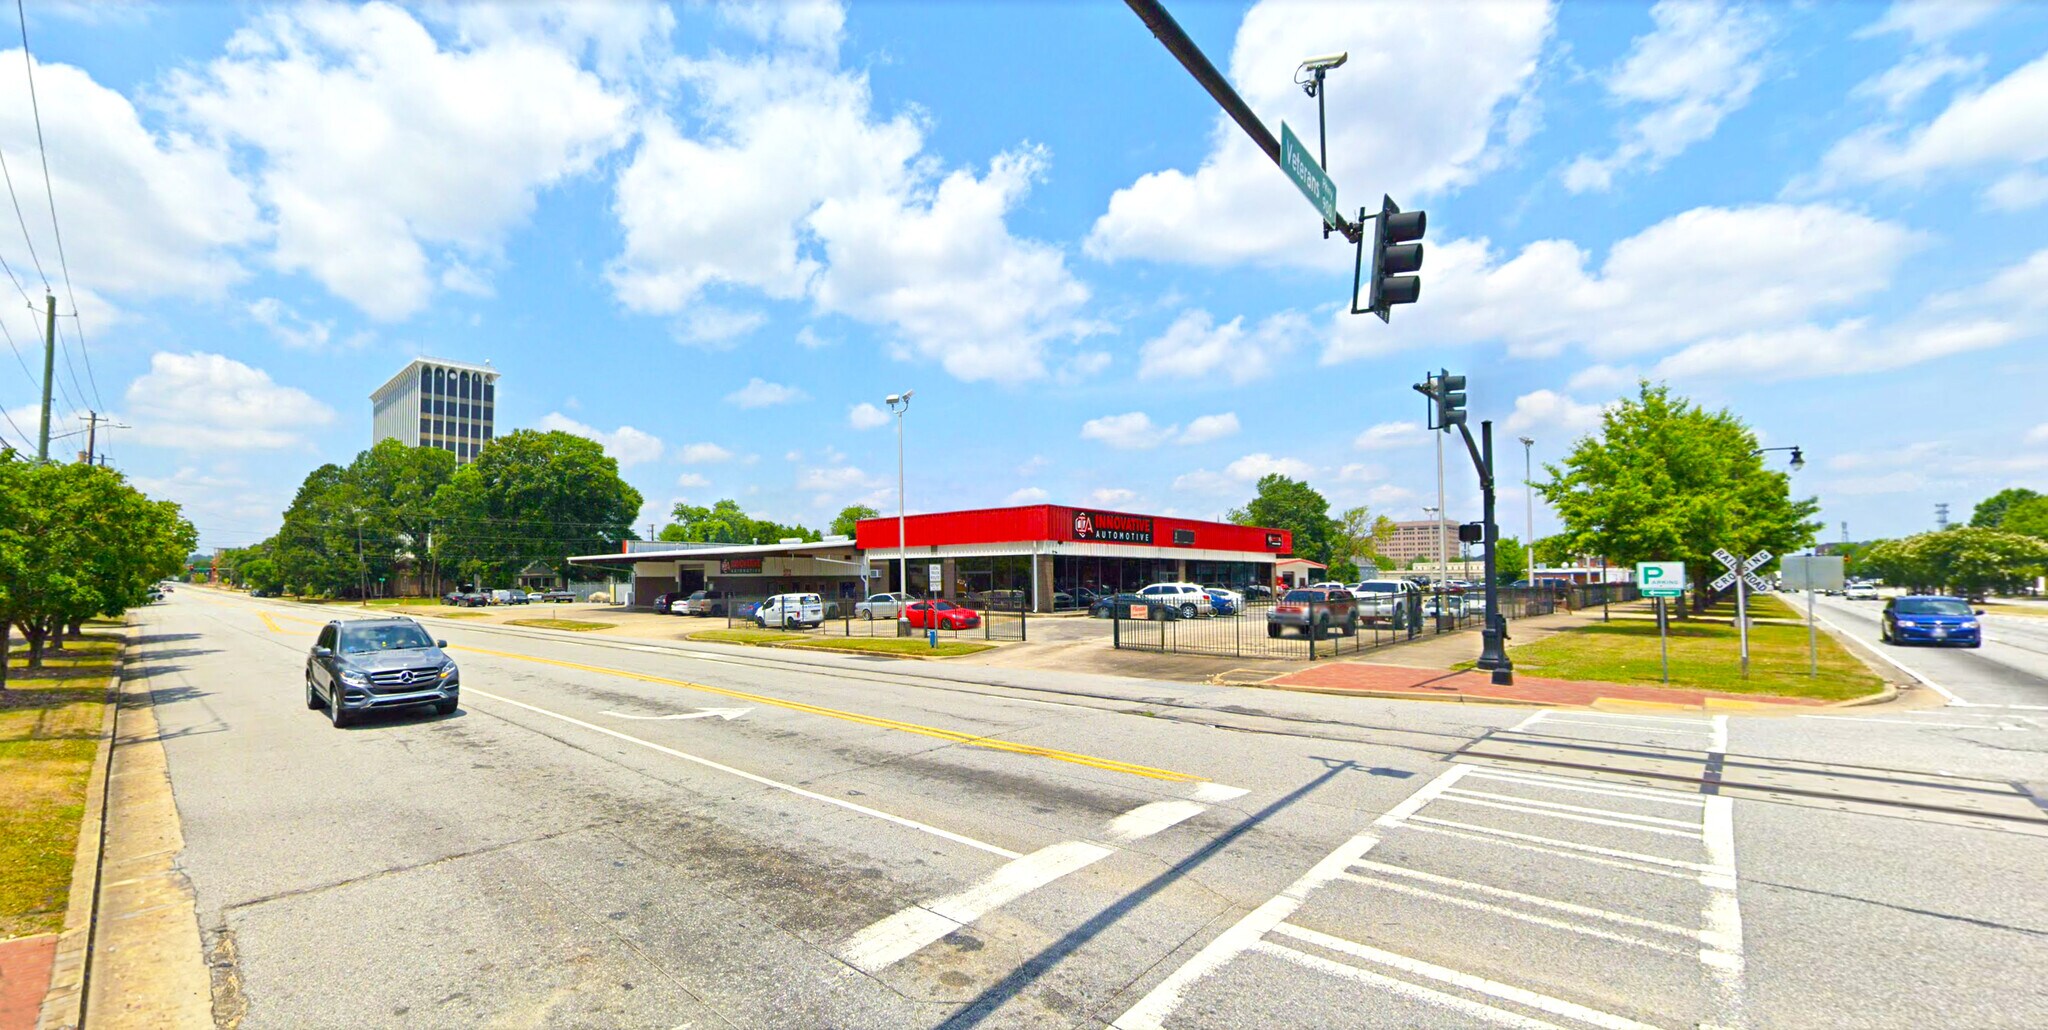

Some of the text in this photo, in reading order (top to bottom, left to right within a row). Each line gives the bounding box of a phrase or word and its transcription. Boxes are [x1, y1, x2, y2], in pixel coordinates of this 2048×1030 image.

[1286, 139, 1319, 199] Veterans
[1095, 514, 1150, 532] INNOVATIVE
[1095, 530, 1149, 542] AUTOMOTIVE
